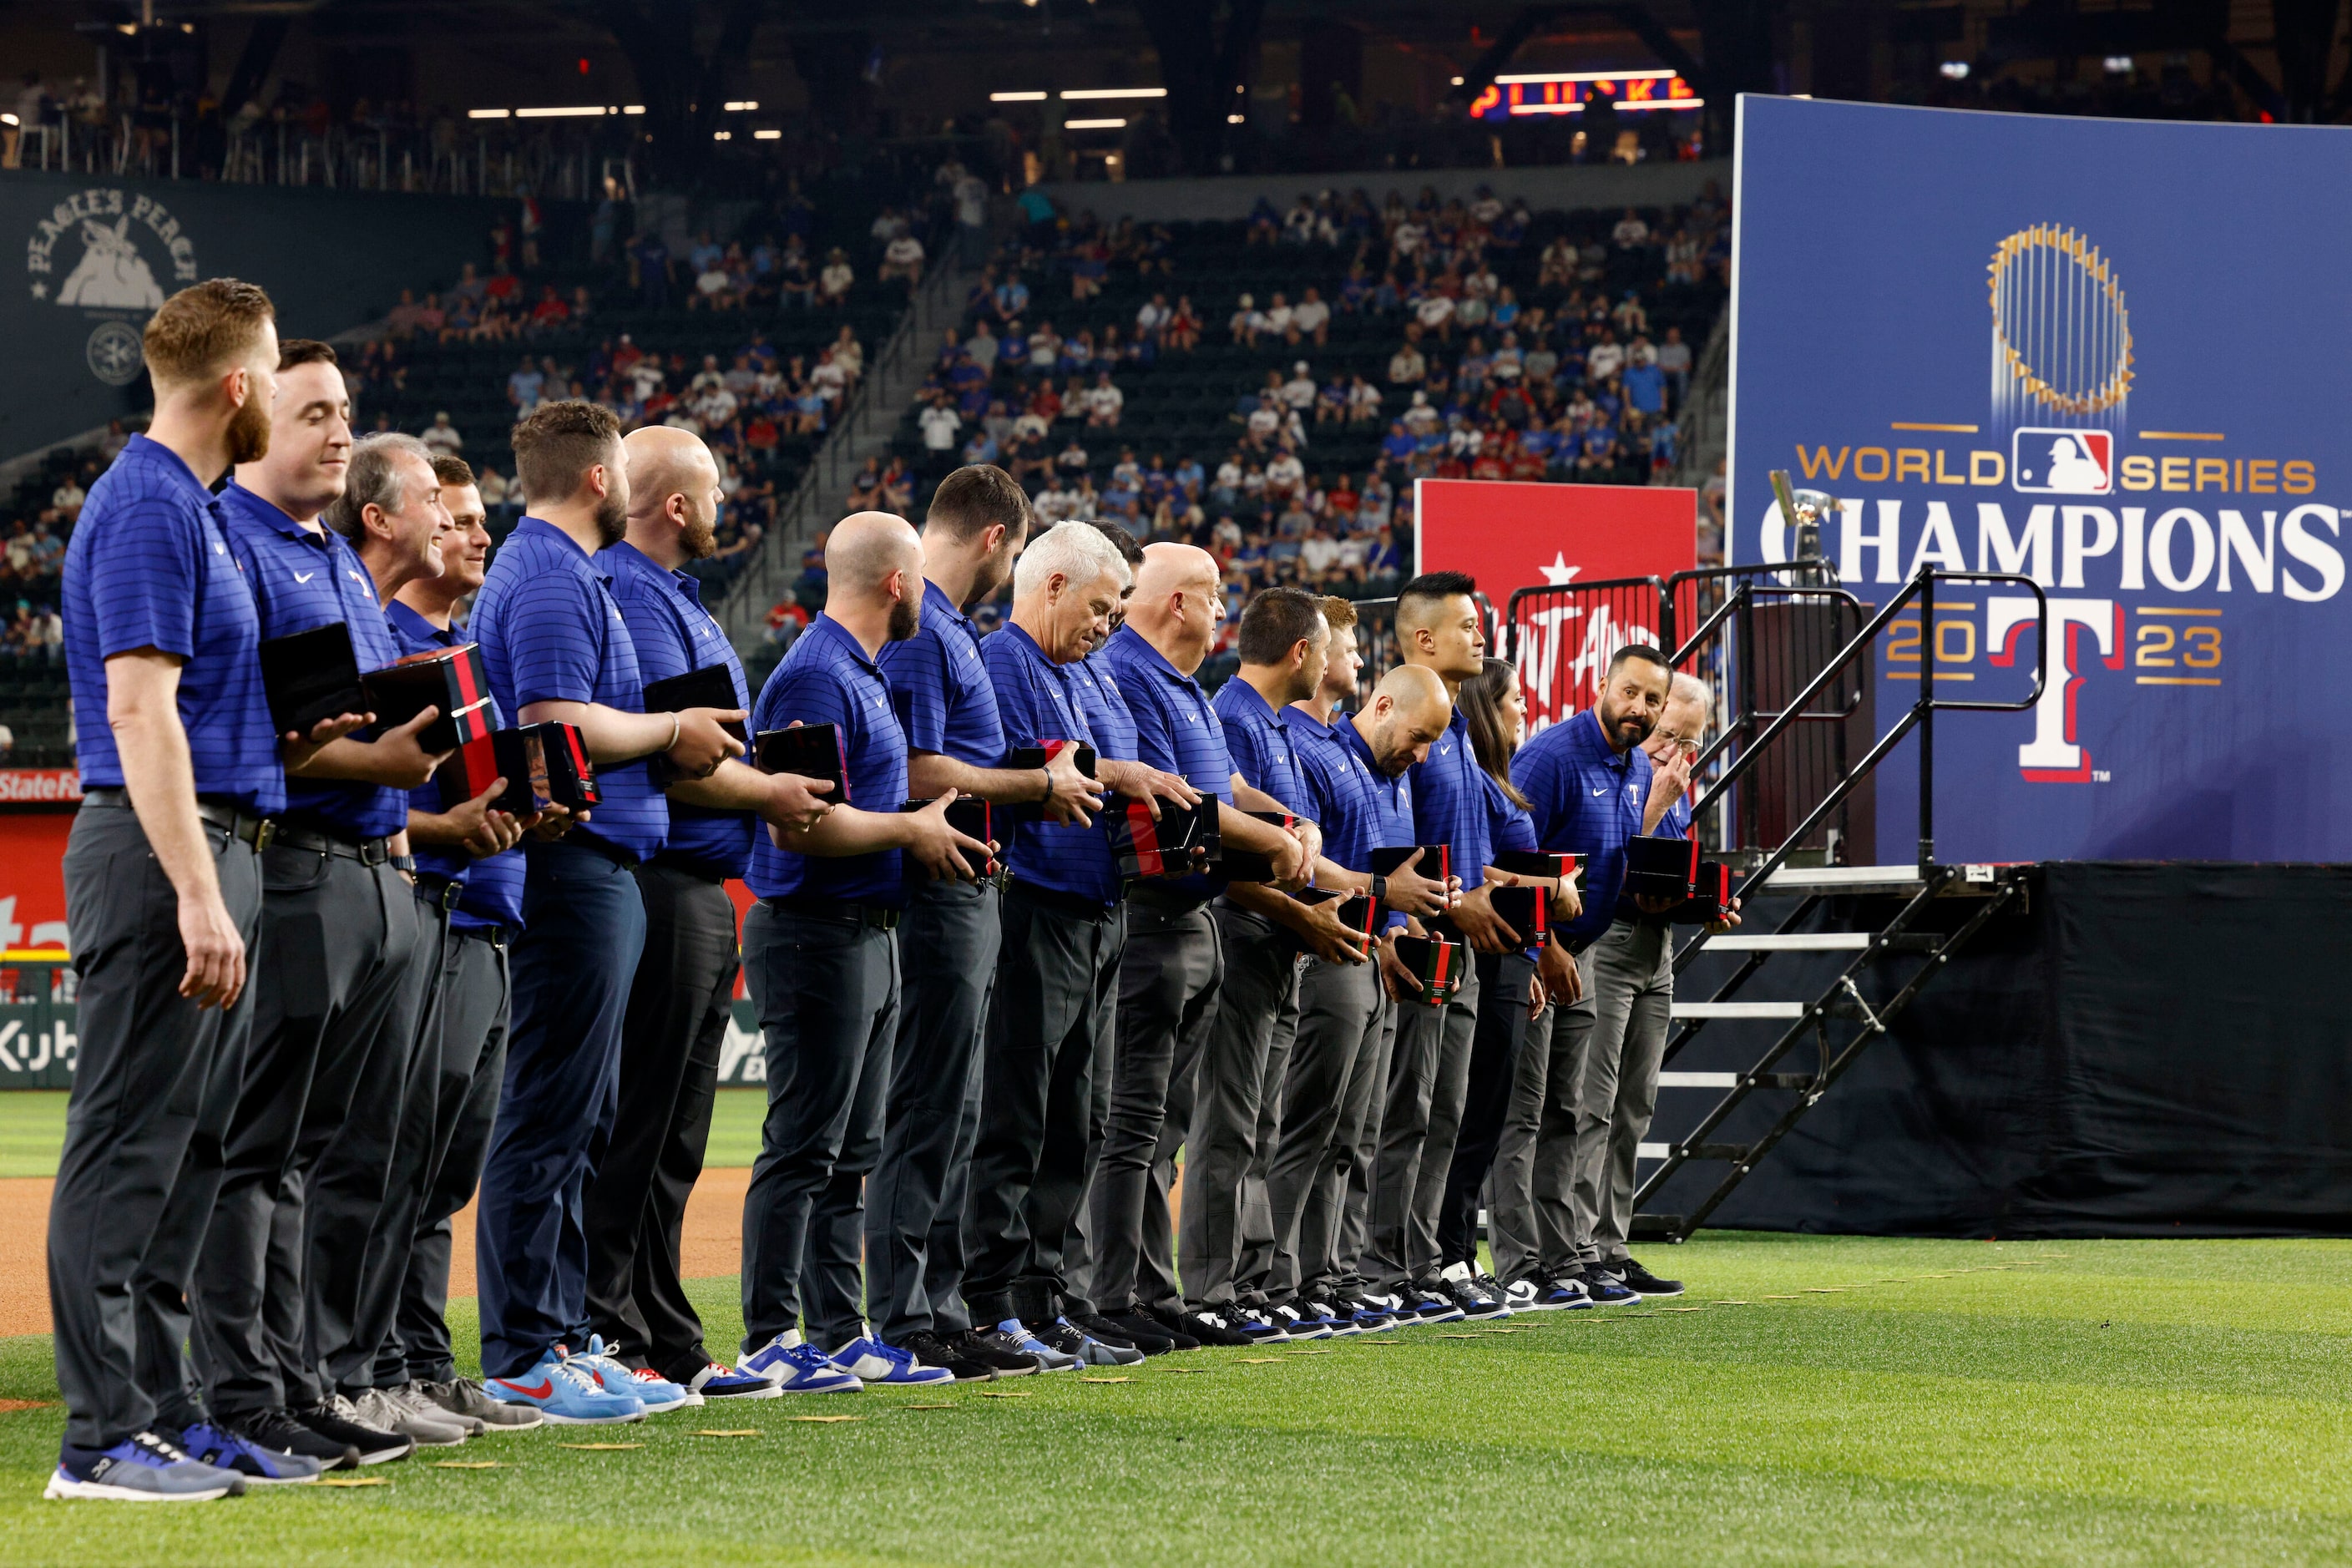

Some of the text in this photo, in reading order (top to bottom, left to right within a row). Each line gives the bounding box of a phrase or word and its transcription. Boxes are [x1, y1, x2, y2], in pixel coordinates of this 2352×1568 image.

[1796, 444, 2316, 494] WORLD SERIES
[1760, 494, 2345, 602] CHAMPIONS
[1886, 620, 2222, 668] 20 23
[1987, 597, 2125, 782] T
